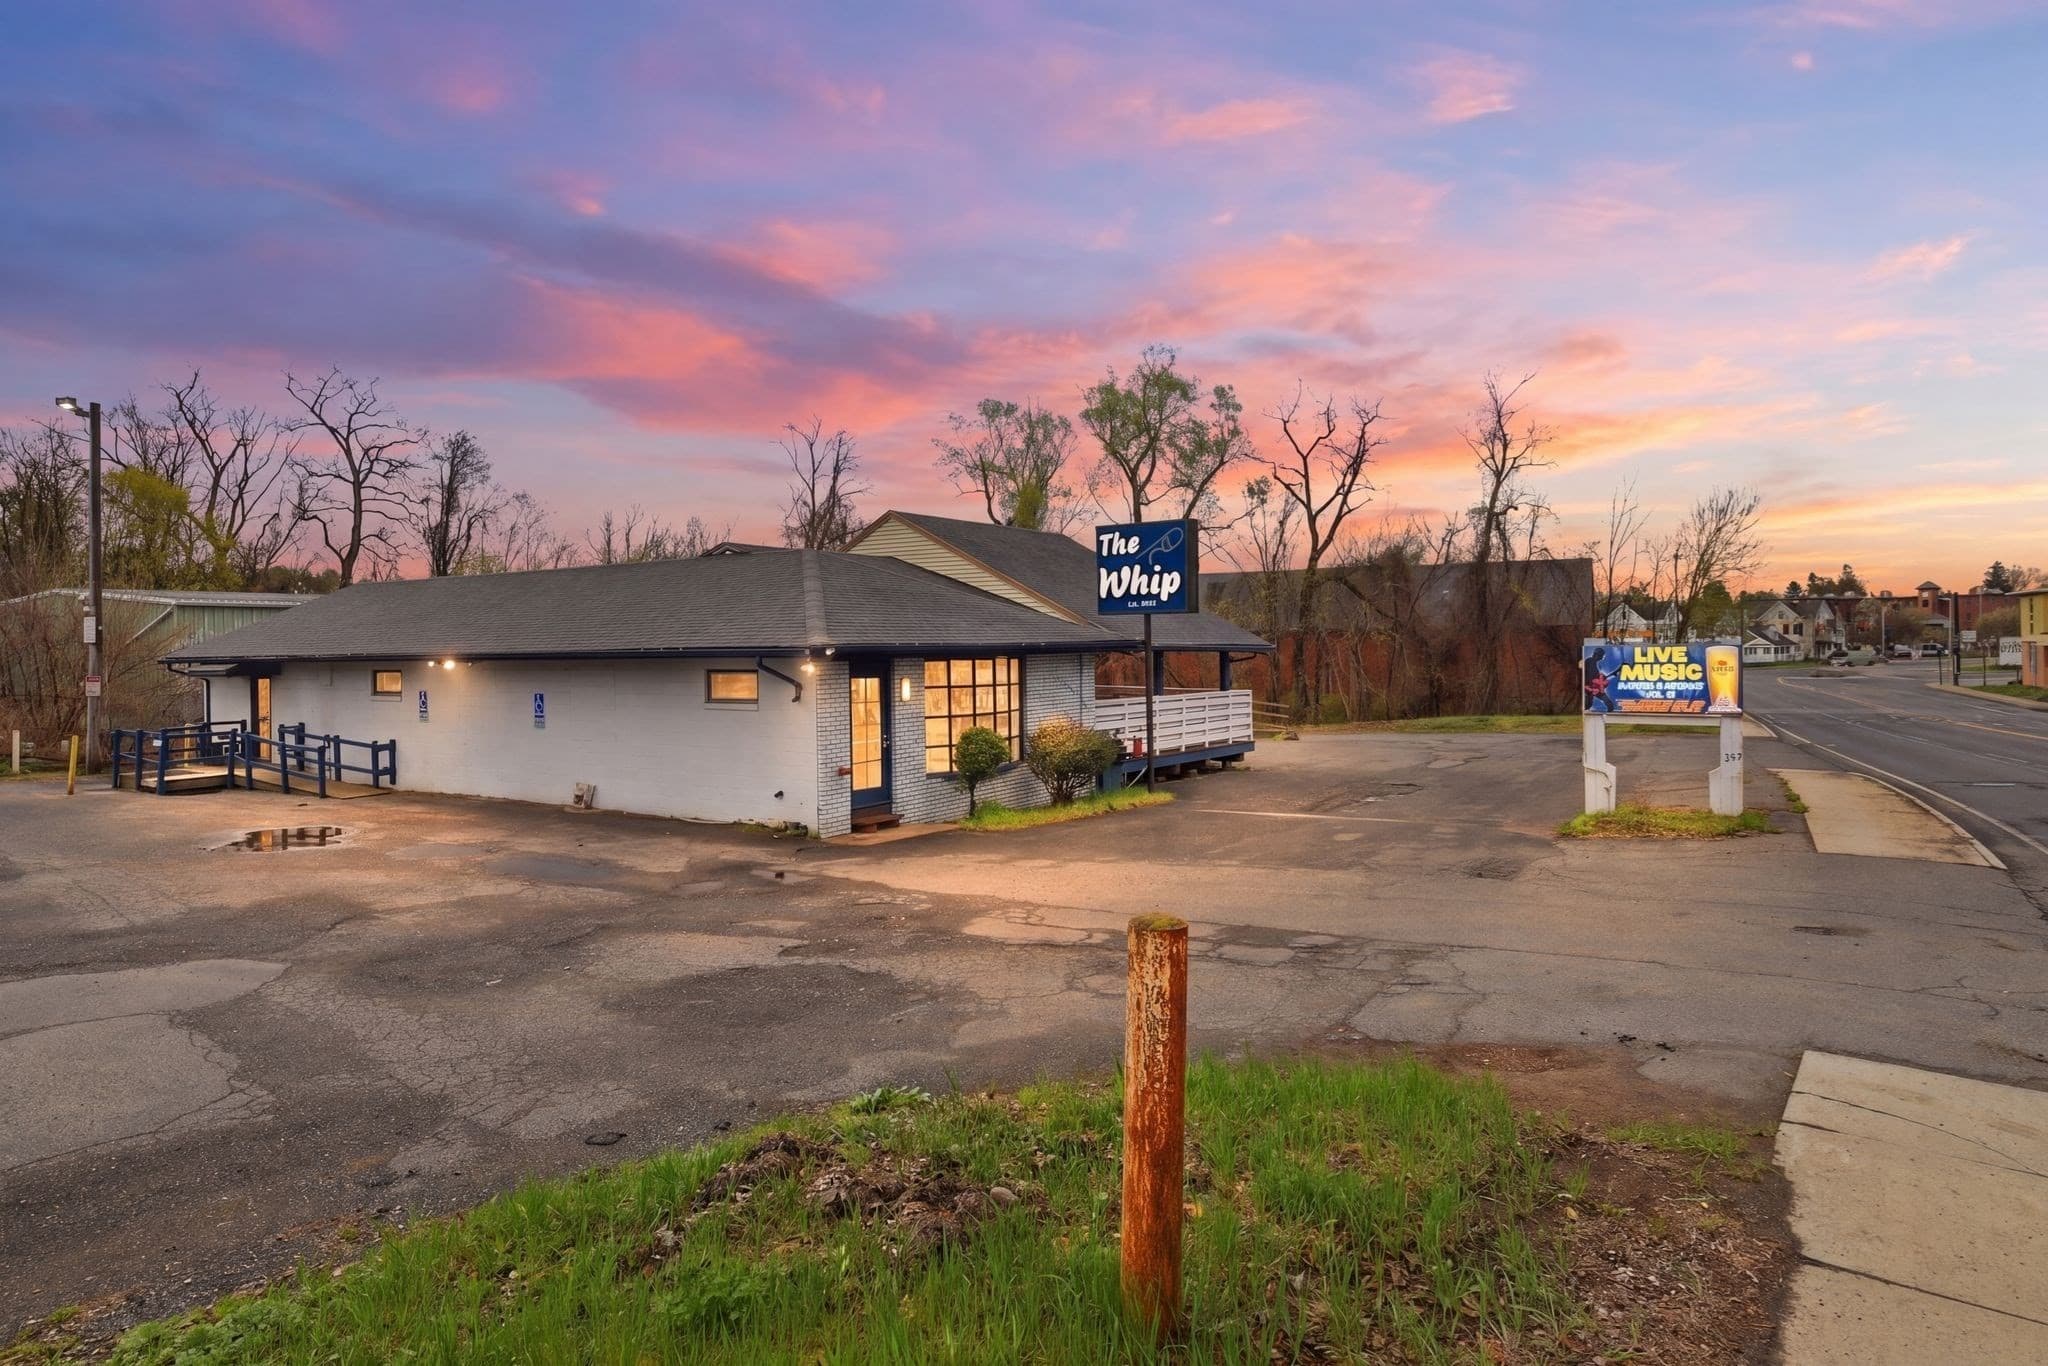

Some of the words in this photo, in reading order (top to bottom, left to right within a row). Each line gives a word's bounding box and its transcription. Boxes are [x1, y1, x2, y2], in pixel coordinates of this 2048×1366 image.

[1099, 532, 1140, 556] The
[1099, 564, 1181, 601] Whip
[1634, 646, 1688, 663] LIVE
[1620, 663, 1703, 681] MUSIC
